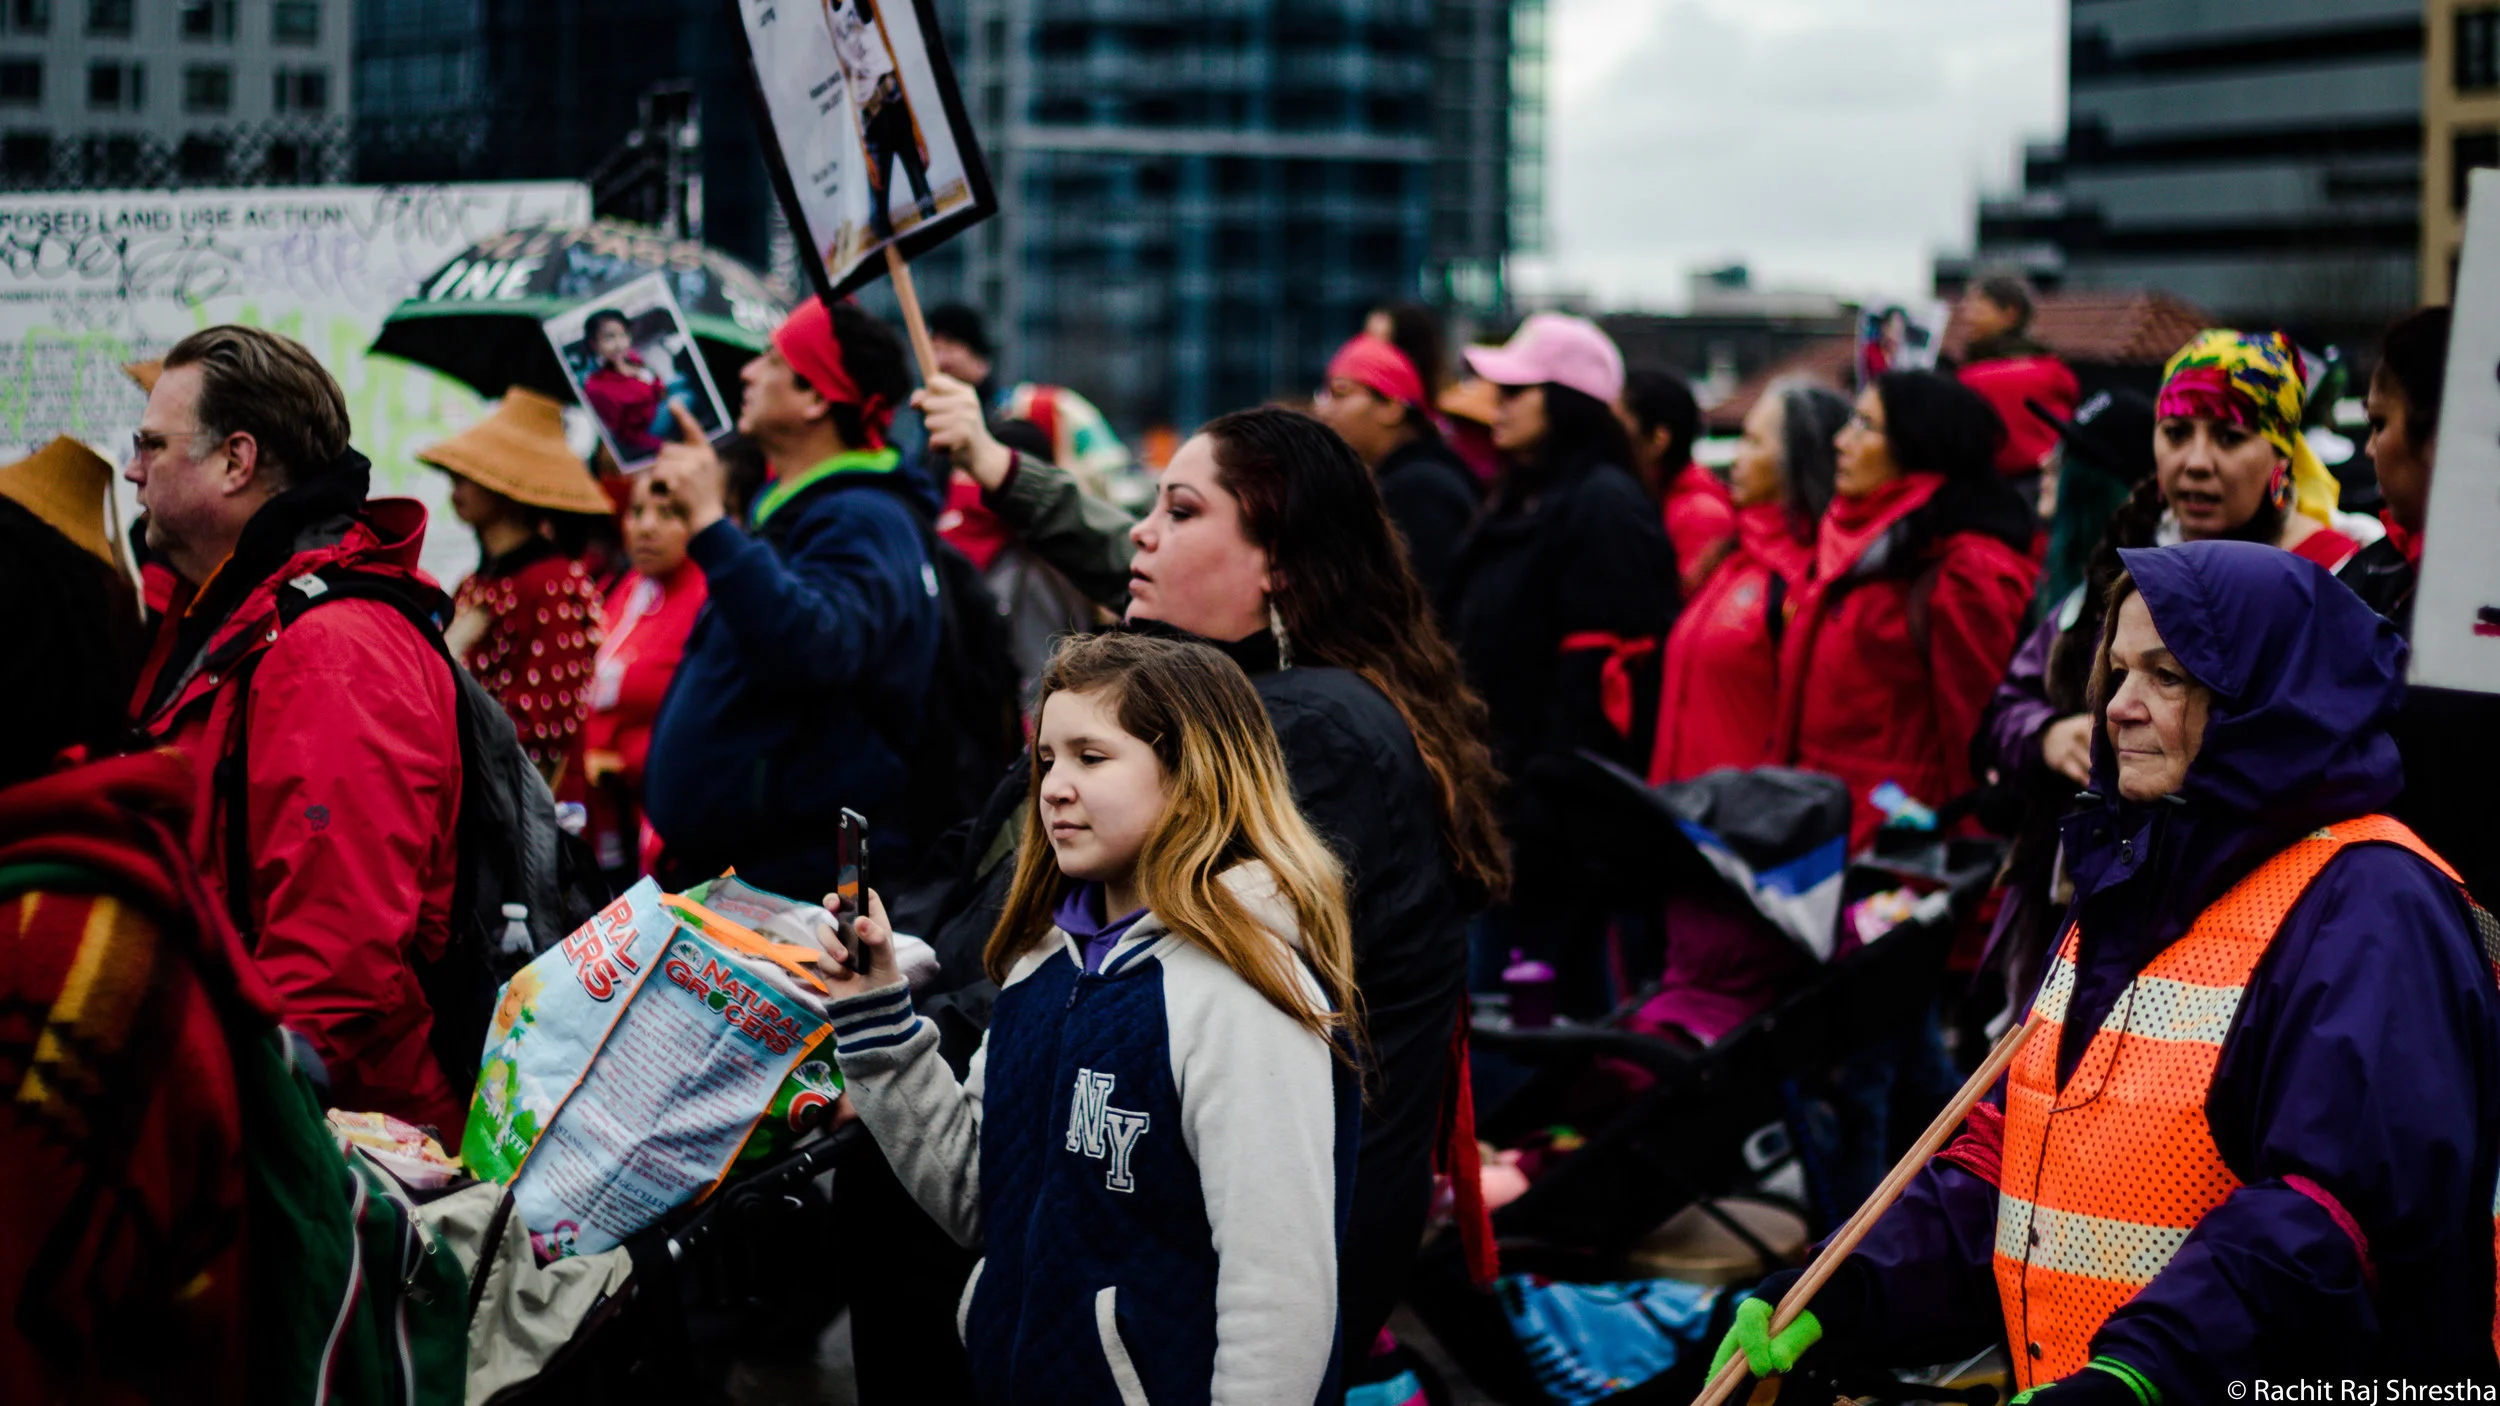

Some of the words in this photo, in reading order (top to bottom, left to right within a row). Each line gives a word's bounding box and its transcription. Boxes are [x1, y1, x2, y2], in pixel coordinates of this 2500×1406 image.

[98, 206, 172, 233] LAND
[181, 208, 232, 233] USE
[246, 206, 342, 233] ACTION
[701, 957, 805, 1042] NATURAL
[1066, 1068, 1150, 1193] NY
